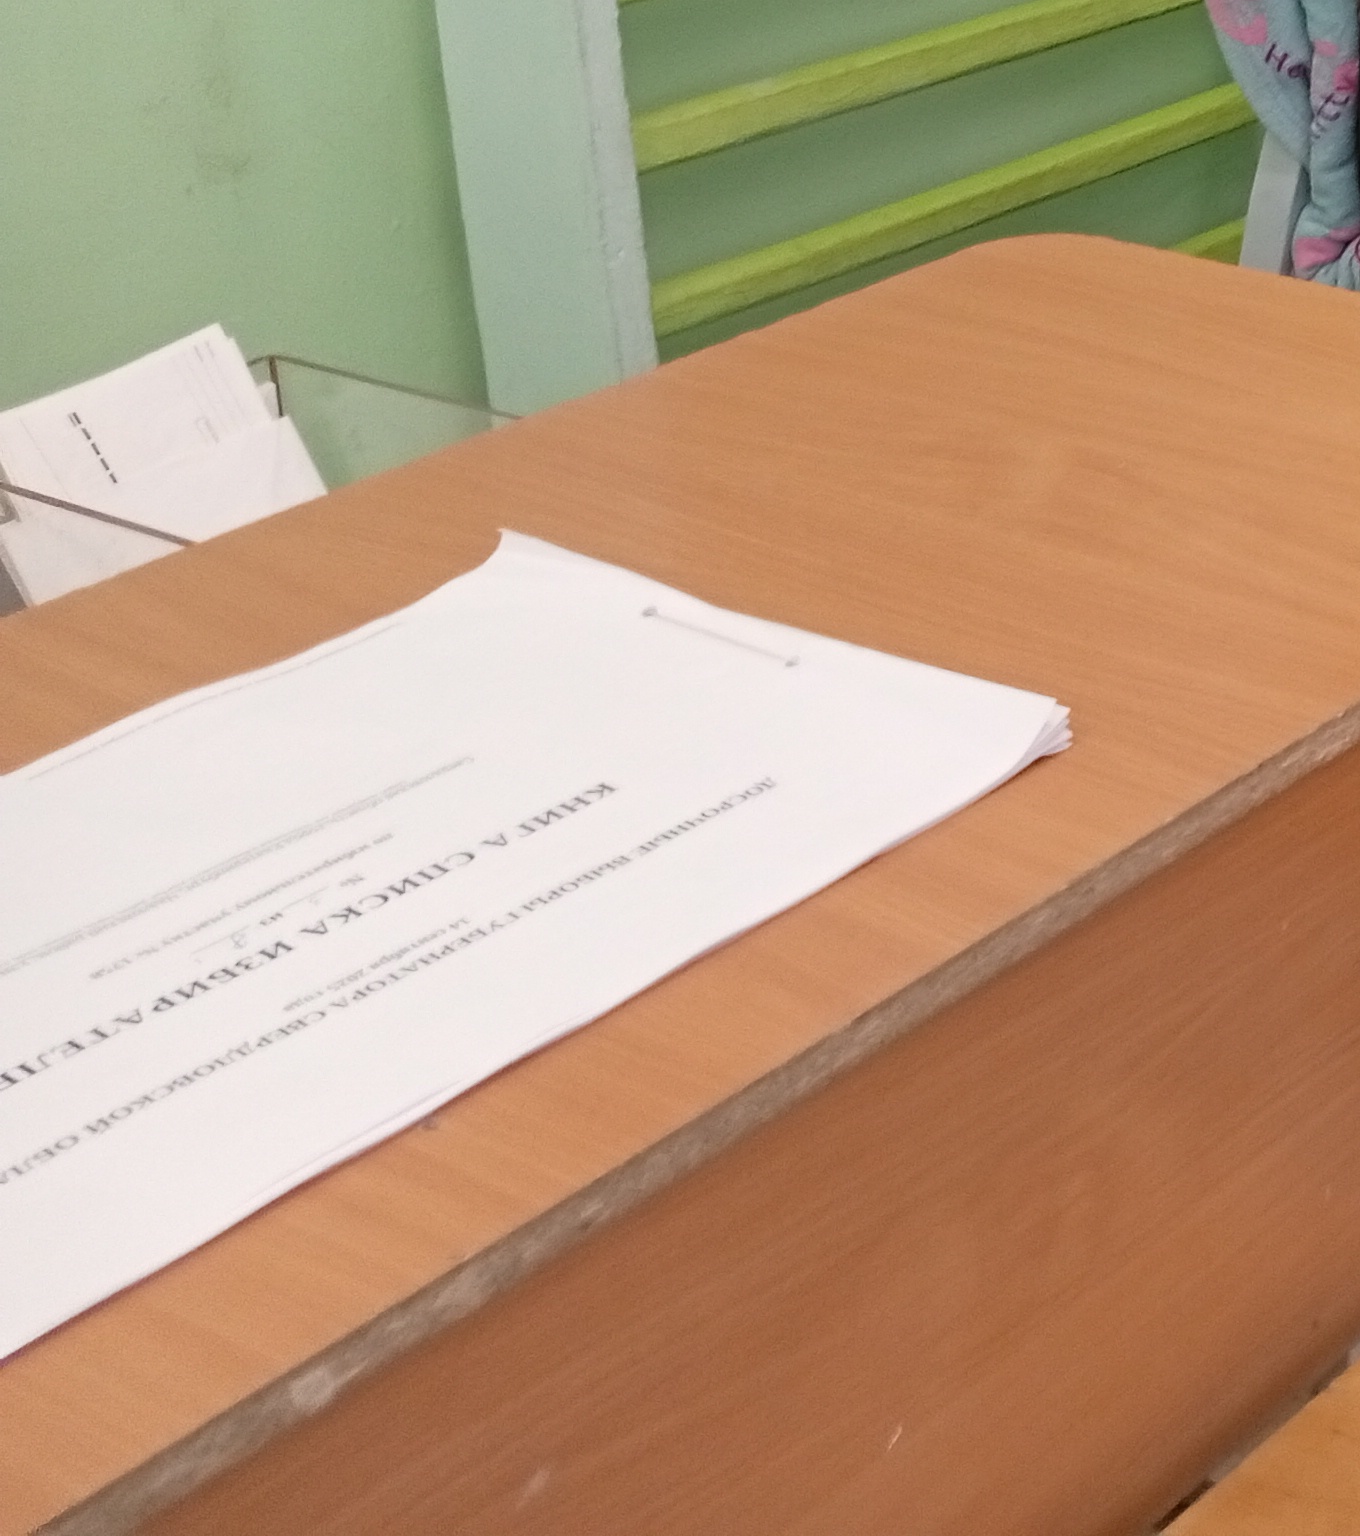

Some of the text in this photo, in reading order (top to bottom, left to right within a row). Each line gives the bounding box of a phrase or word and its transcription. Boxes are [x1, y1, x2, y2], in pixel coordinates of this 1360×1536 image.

[481, 782, 616, 846] КНИГА
[299, 852, 475, 934] СПИСКА
[520, 855, 631, 911] ВЫБОРЫ
[329, 911, 520, 1007] ГУБЕРНАТОРА
[83, 1010, 326, 1134] СВЕРДЛОВСКОЙ
